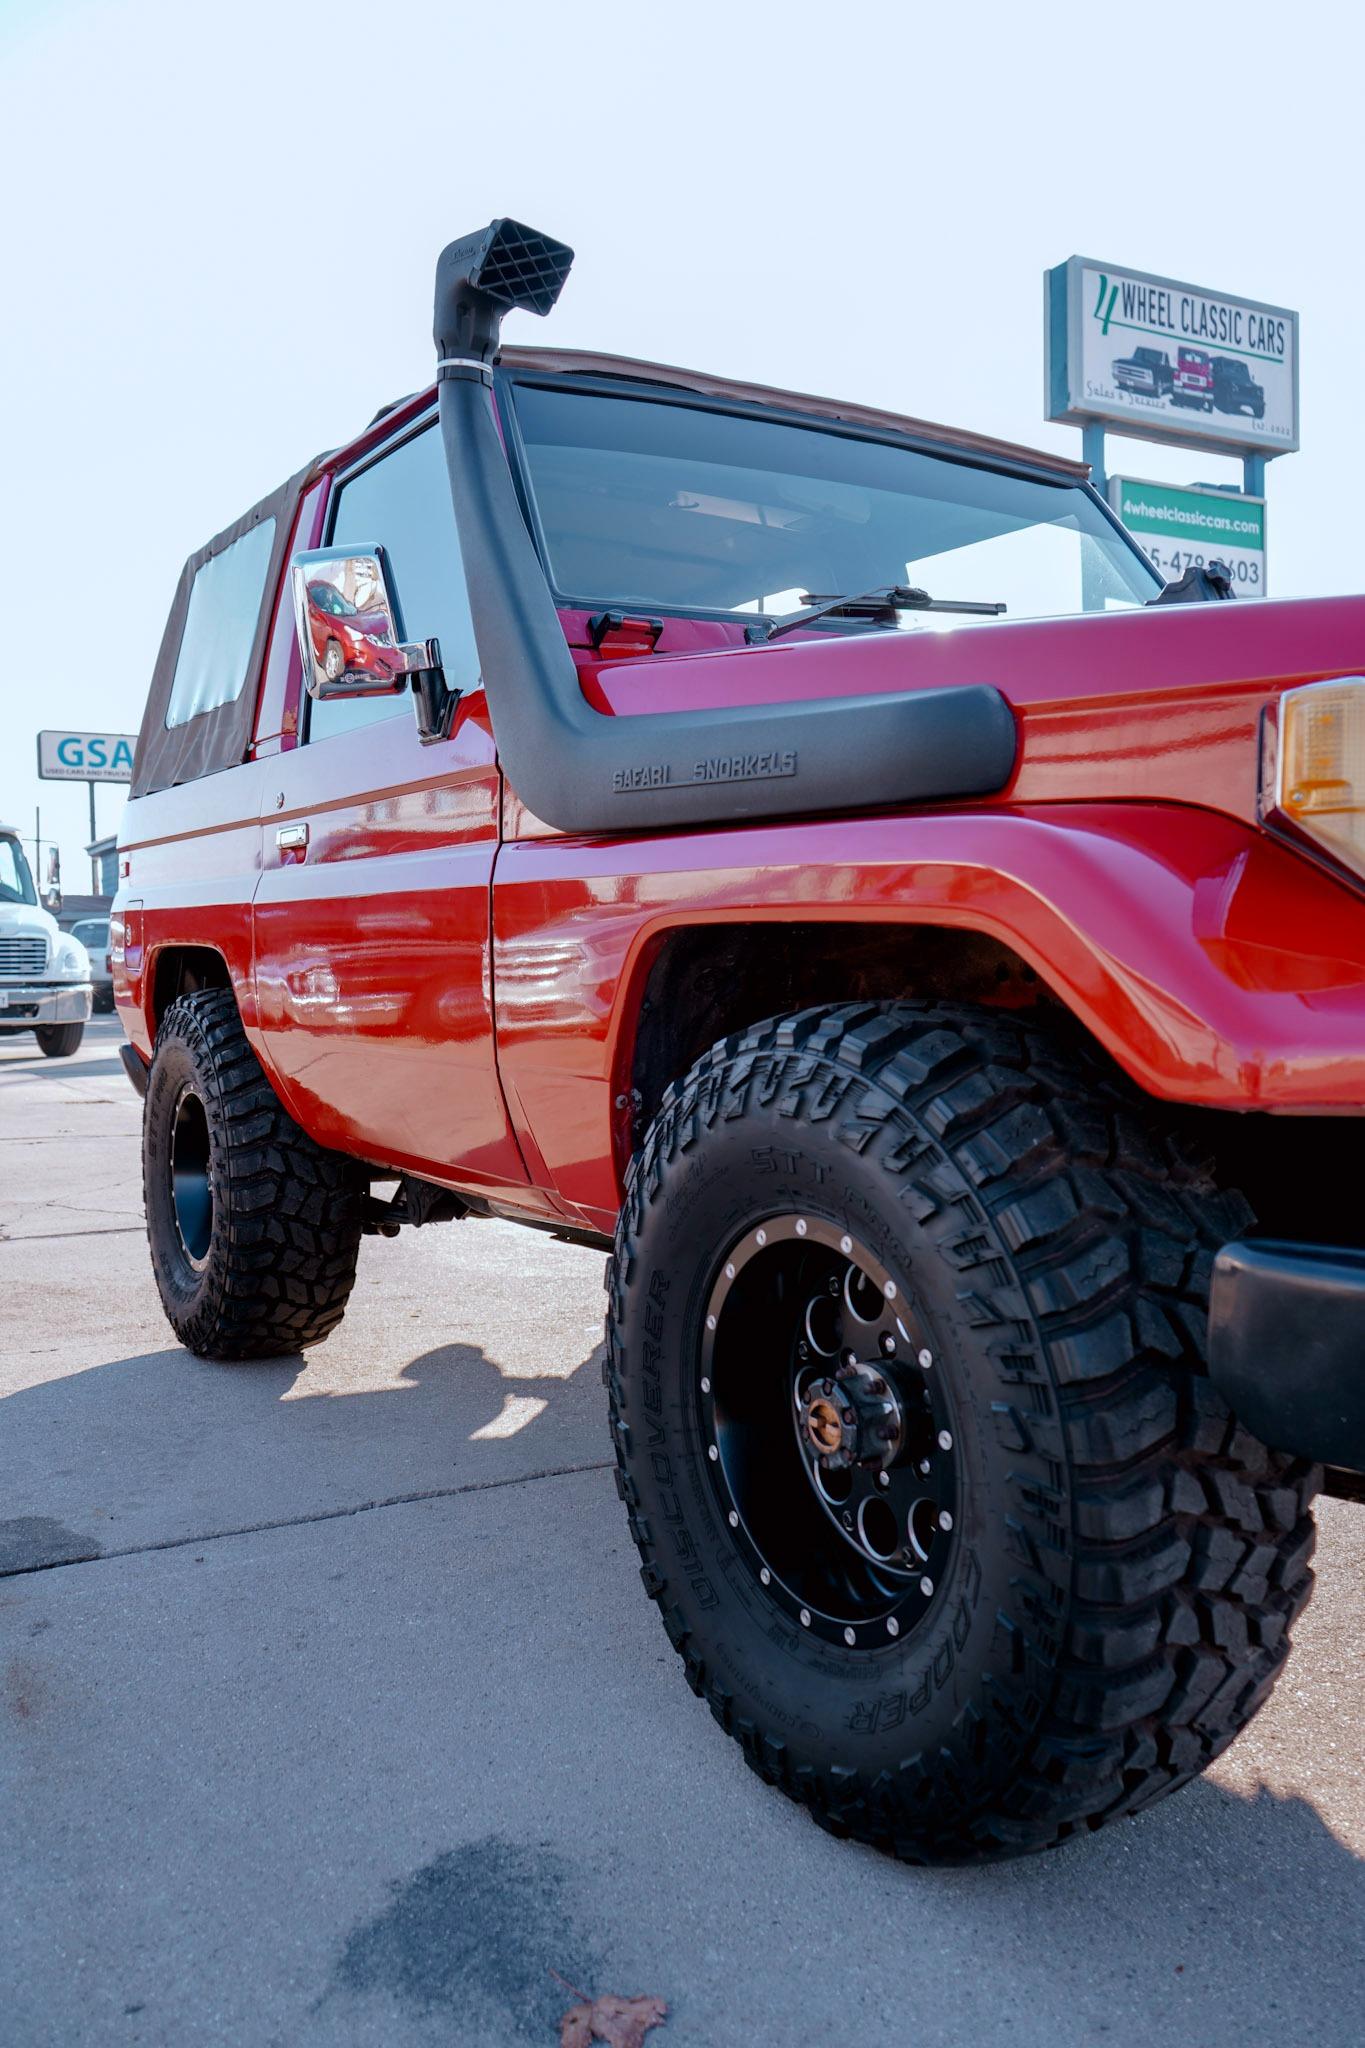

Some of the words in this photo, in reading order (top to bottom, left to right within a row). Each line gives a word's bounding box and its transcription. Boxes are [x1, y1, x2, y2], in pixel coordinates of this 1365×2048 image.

[1094, 274, 1119, 336] 4
[1121, 281, 1175, 330] WHEEL
[1181, 297, 1242, 346] CLASSIC
[1248, 311, 1285, 356] CARS
[1086, 380, 1115, 399] Sales
[1122, 499, 1260, 535] 4wheelclassiccars.com
[57, 737, 134, 769] GSA
[611, 764, 671, 789] SAFARI
[693, 750, 799, 782] SNORKELS
[66, 768, 85, 776] CARS
[86, 769, 102, 777] AND
[640, 1267, 721, 1612] DISCOVERER
[847, 1549, 982, 1737] COOPER
